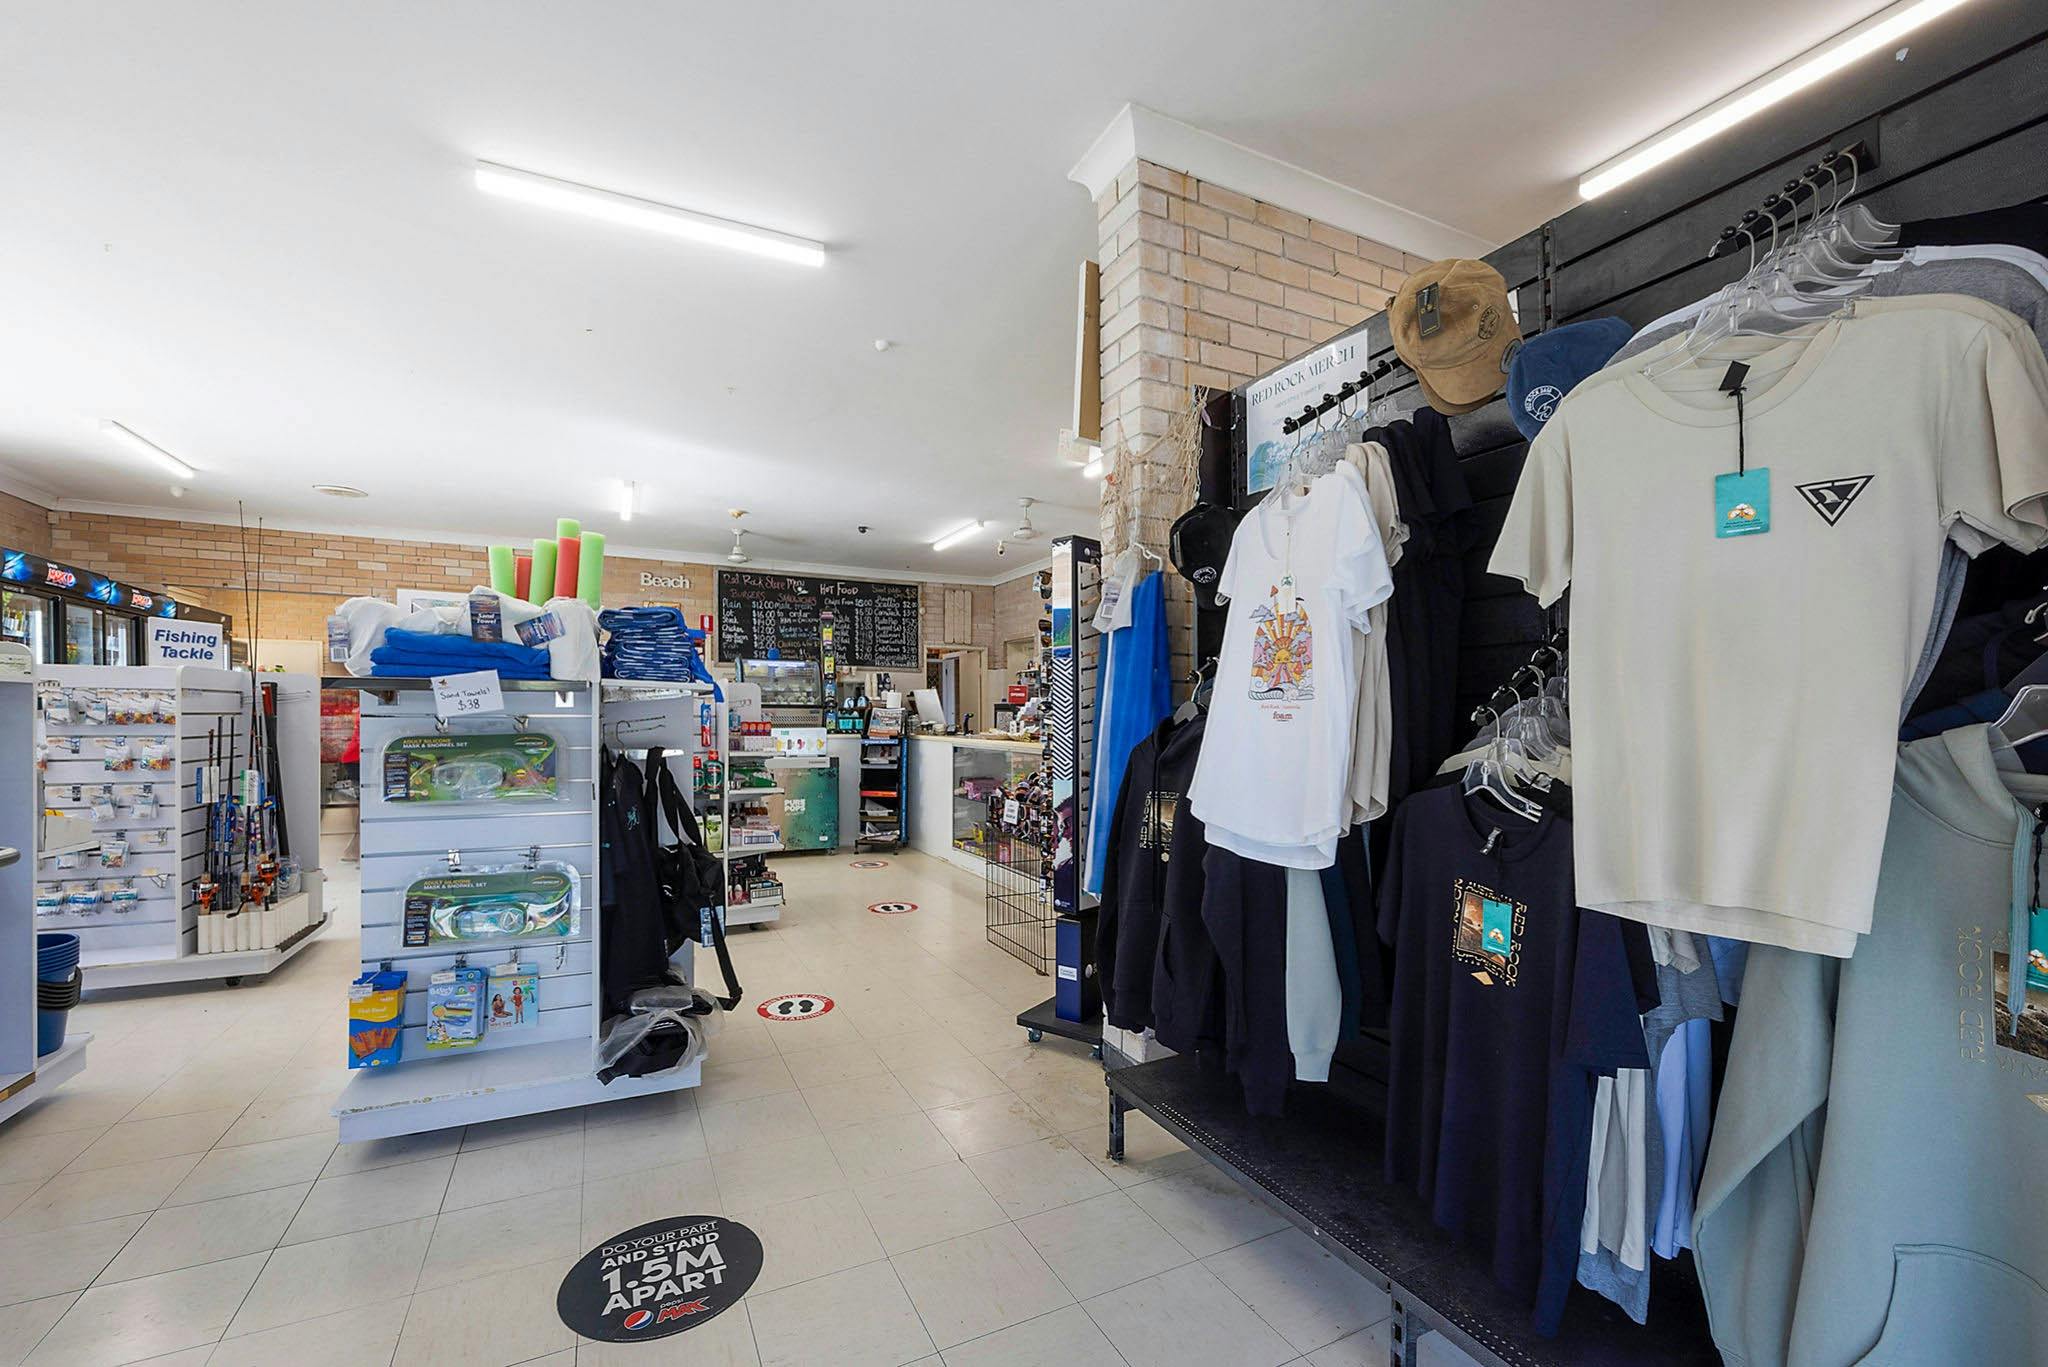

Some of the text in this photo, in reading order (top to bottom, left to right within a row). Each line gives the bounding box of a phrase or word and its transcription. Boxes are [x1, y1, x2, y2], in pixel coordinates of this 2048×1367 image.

[1252, 345, 1355, 406] RED ROCK MERCH
[640, 572, 690, 589] Beach
[154, 629, 217, 648] Fishing
[160, 645, 214, 660] Tackle
[440, 691, 460, 700] Sand
[457, 699, 480, 711] $38
[1272, 711, 1293, 719] foam
[1505, 901, 1527, 987] RED ROCK
[1958, 926, 1986, 1064] RED ROCK
[601, 1220, 718, 1258] DO YOUR PART
[601, 1232, 720, 1270] AND STAND
[602, 1244, 726, 1294] 1.5M
[601, 1265, 727, 1316] APART
[659, 1298, 684, 1309] pepsi
[656, 1296, 711, 1324] MAX
